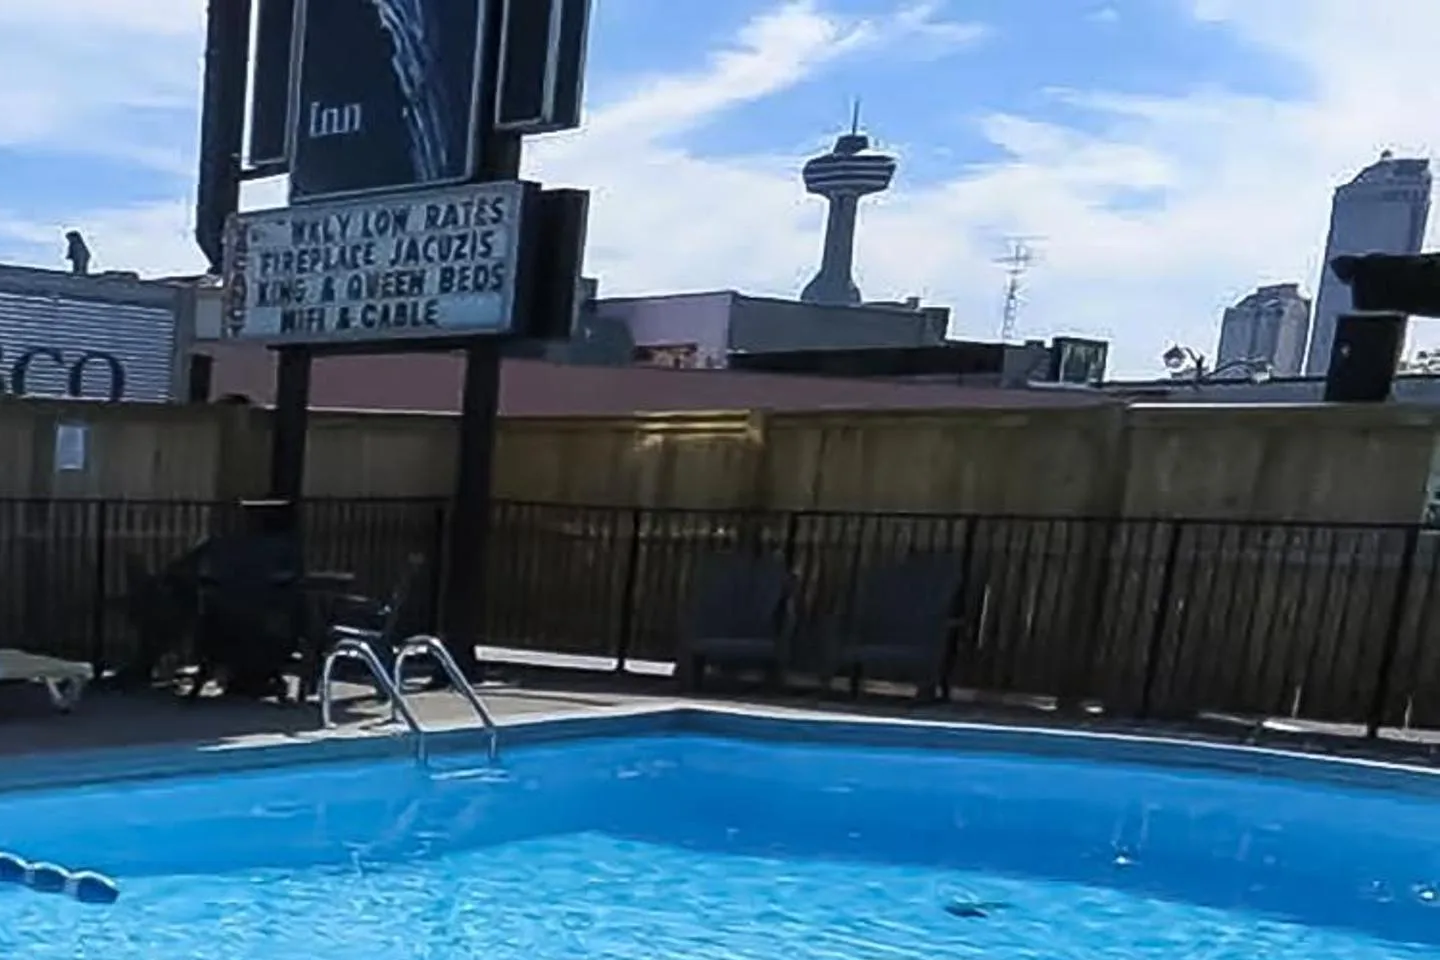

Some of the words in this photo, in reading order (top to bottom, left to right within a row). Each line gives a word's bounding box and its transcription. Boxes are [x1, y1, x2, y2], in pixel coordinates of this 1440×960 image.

[310, 102, 360, 138] Inn
[362, 206, 410, 238] LOW
[425, 197, 505, 230] RATES
[261, 243, 376, 276] FIREPLACE
[389, 230, 494, 267] JACUZIS
[347, 268, 426, 301] QUEEN
[439, 262, 505, 294] BEDS
[361, 299, 438, 329] CABLE
